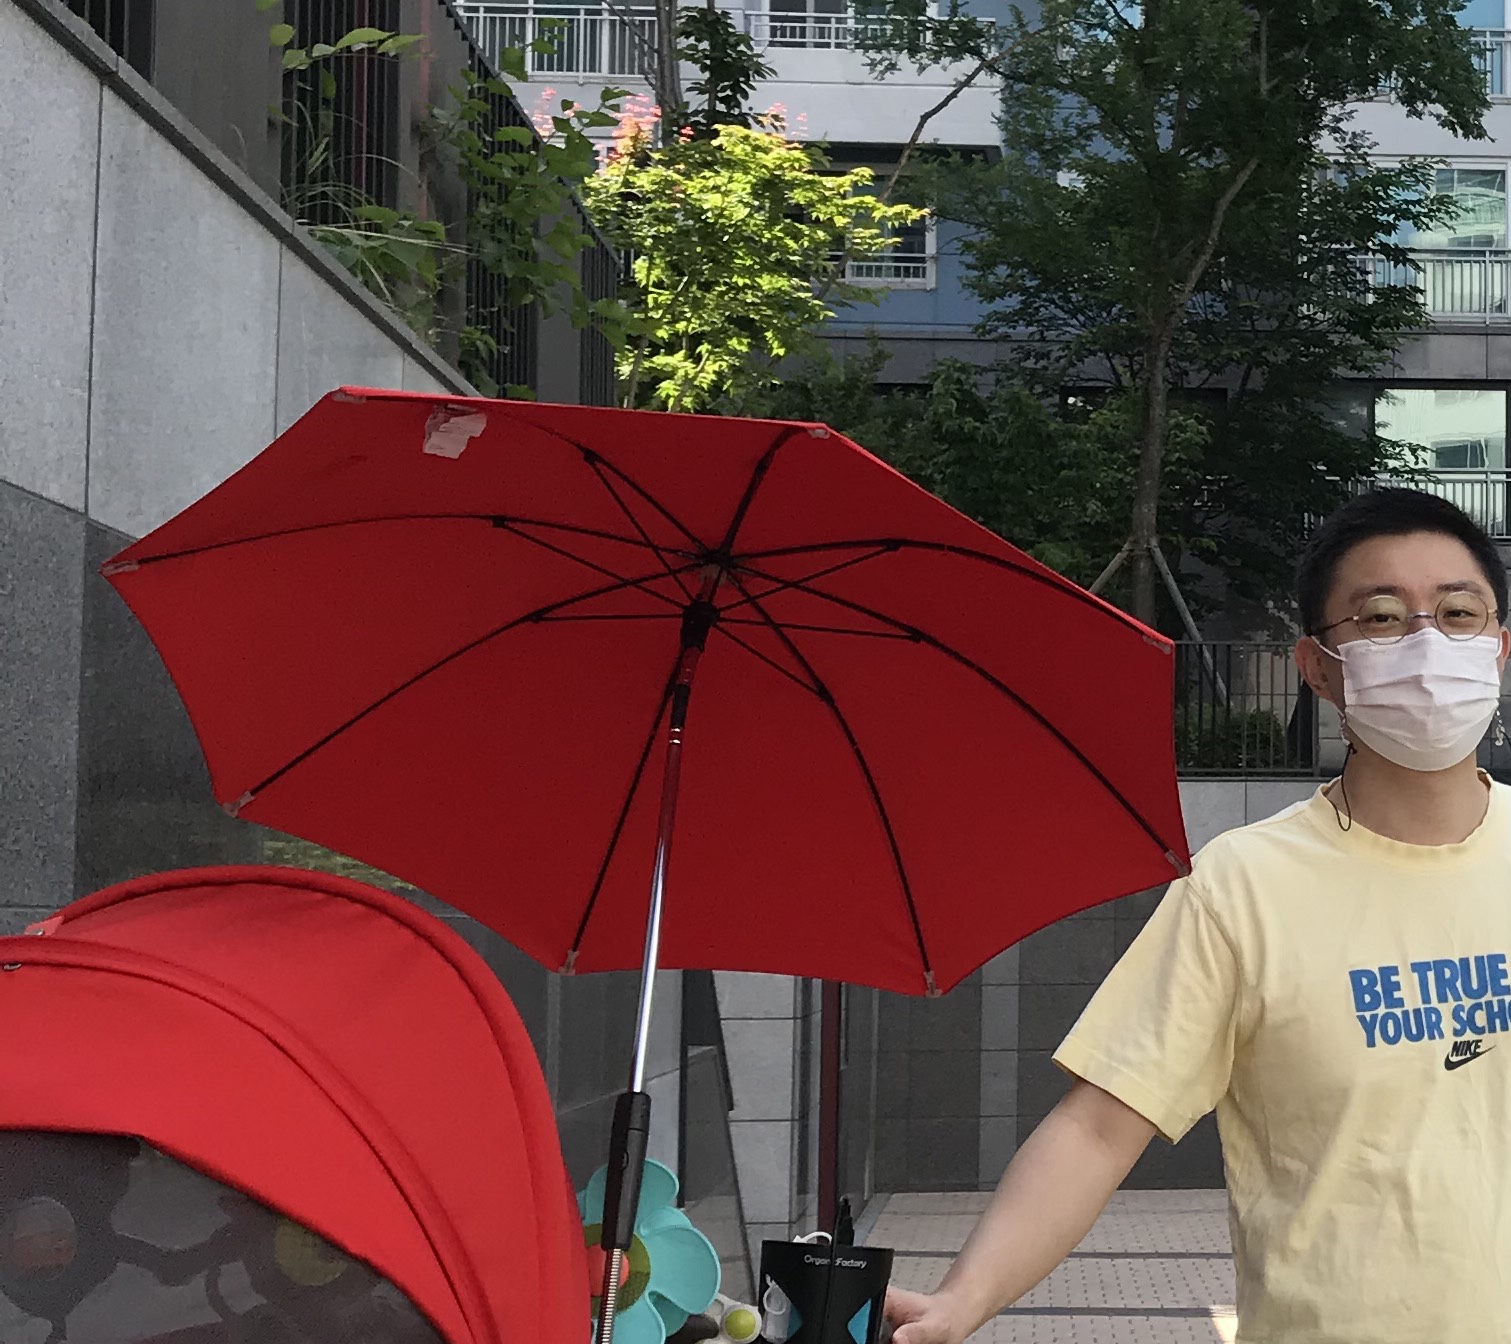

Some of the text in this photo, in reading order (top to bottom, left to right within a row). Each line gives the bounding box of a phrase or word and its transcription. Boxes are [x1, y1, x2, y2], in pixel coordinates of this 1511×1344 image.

[1349, 965, 1405, 1012] BE
[1411, 954, 1511, 1005] TRUE
[1356, 1007, 1444, 1048] YOUR
[1451, 1039, 1483, 1057] NIKE
[835, 1257, 867, 1269] Factory
